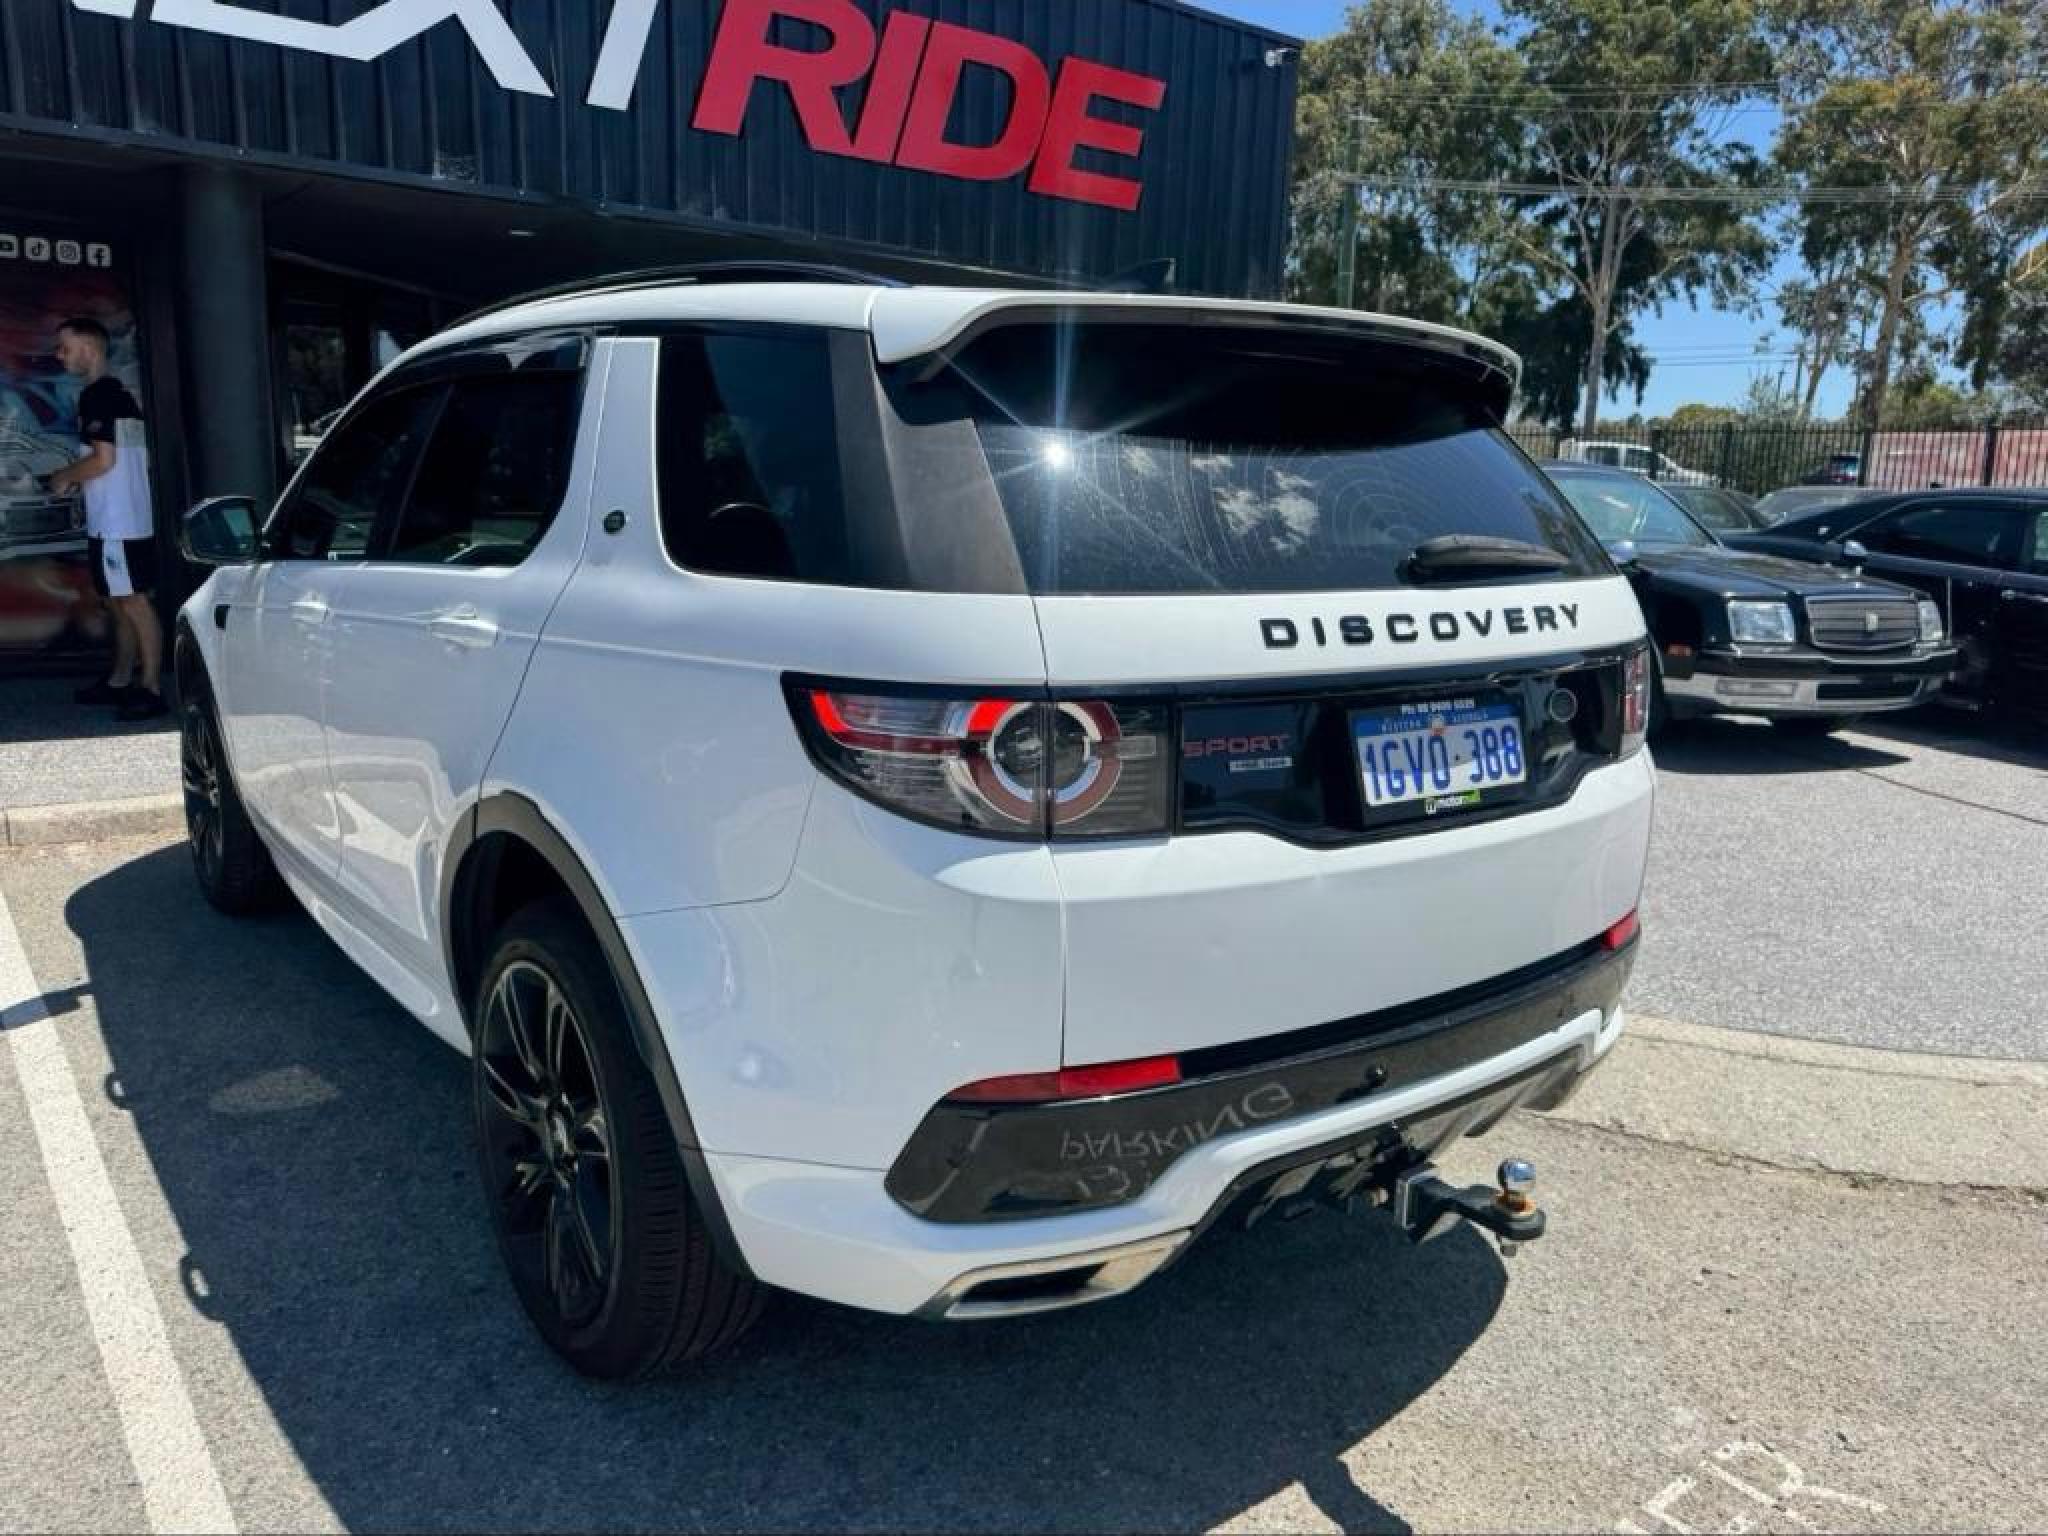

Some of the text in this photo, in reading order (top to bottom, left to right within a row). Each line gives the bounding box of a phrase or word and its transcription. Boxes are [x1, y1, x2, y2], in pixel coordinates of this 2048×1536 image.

[691, 0, 1166, 211] RIDE
[1259, 602, 1580, 649] DISCOVERY
[1183, 734, 1291, 758] SPORT
